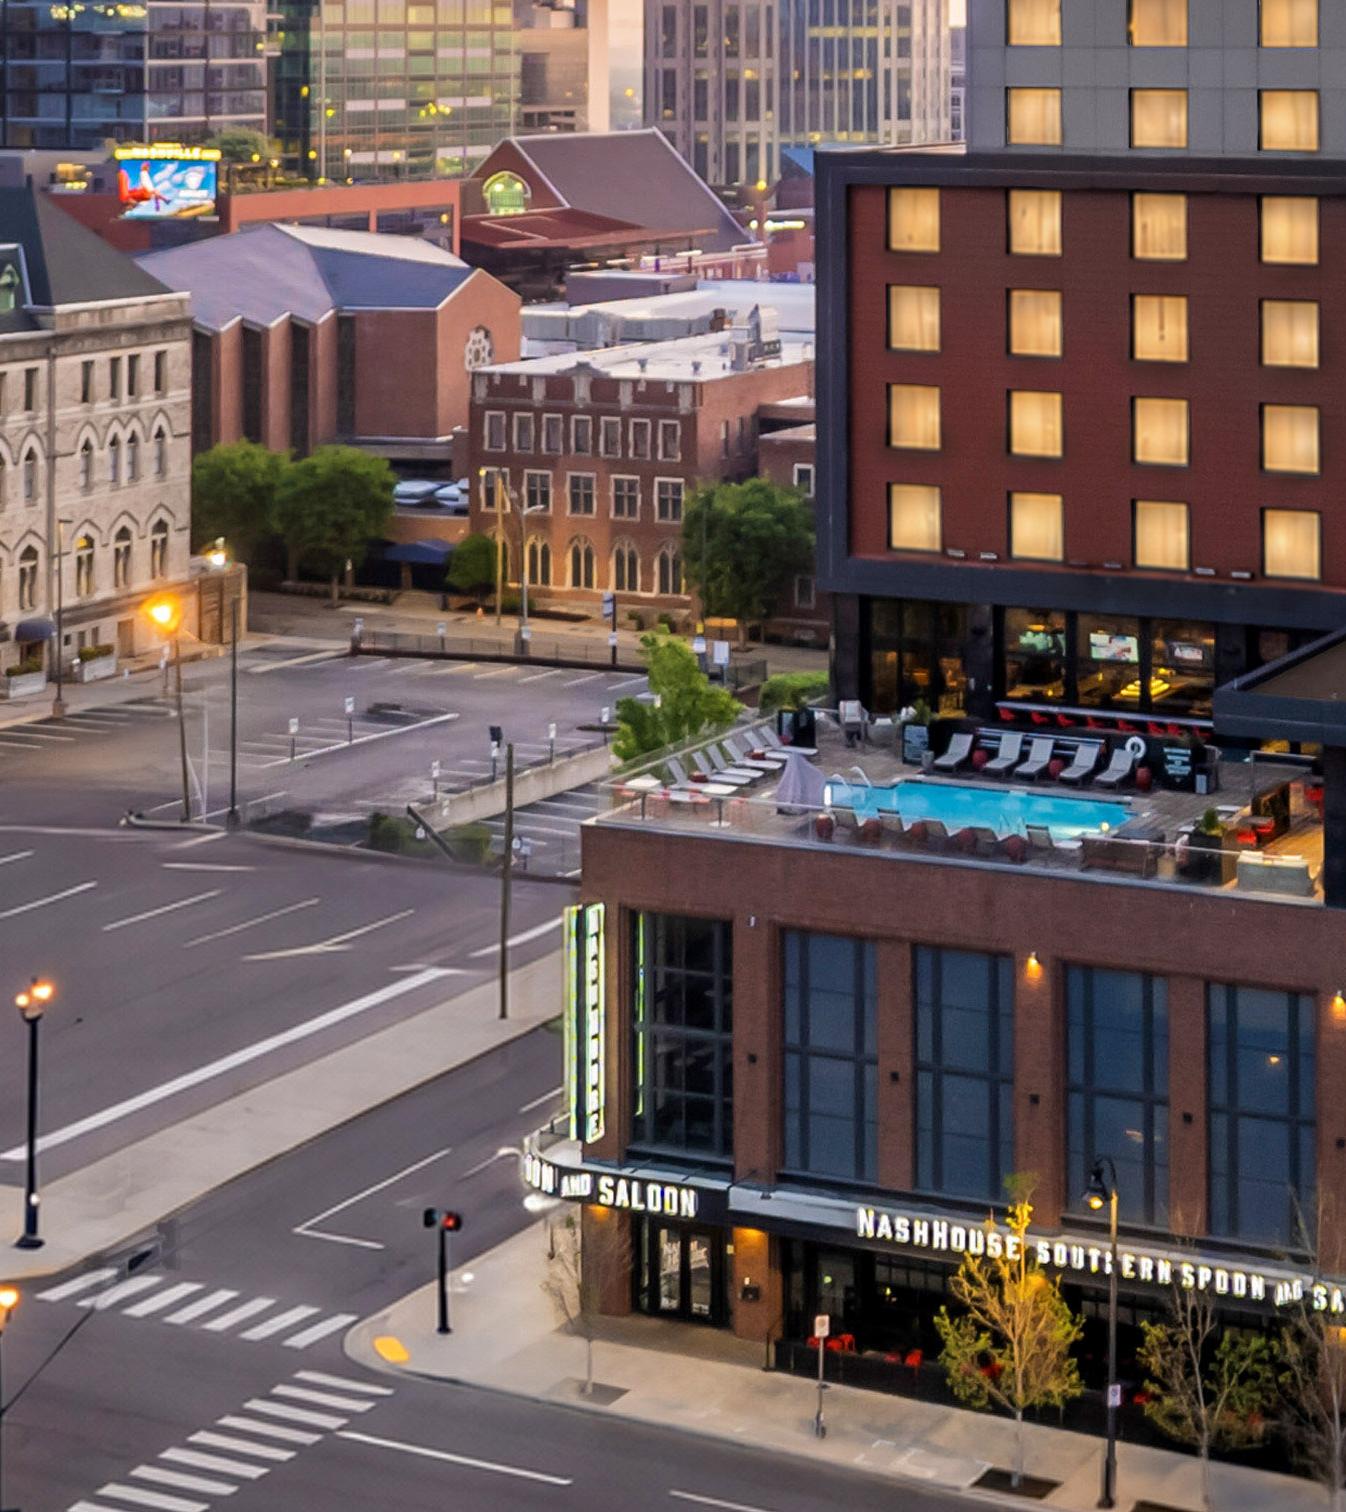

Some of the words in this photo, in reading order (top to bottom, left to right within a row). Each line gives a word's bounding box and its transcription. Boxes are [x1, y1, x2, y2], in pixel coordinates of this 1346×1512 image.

[561, 1173, 592, 1198] AND
[598, 1175, 696, 1218] SALOON
[857, 1207, 1020, 1261] NASHHOUSE
[1181, 1262, 1265, 1300] SPOON
